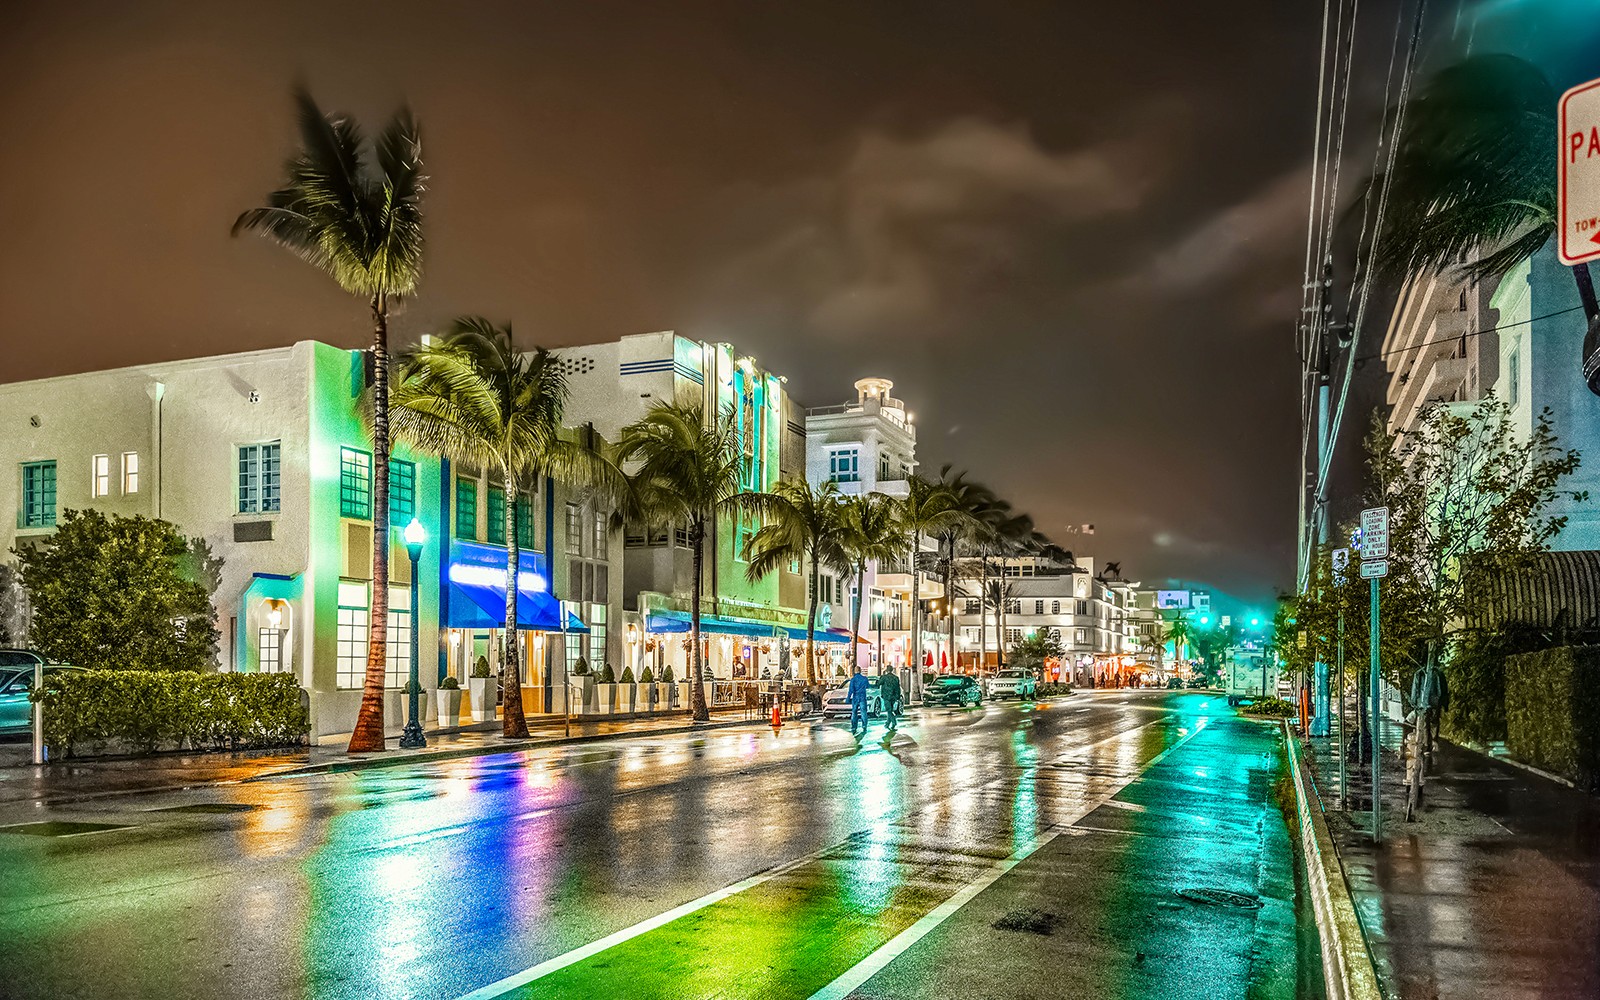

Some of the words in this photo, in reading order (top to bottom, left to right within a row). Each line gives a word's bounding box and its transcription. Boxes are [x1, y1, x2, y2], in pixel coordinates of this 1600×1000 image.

[1364, 510, 1385, 518] PASSENGER
[1366, 517, 1383, 525] LOADING
[1364, 529, 1385, 537] PARKING
